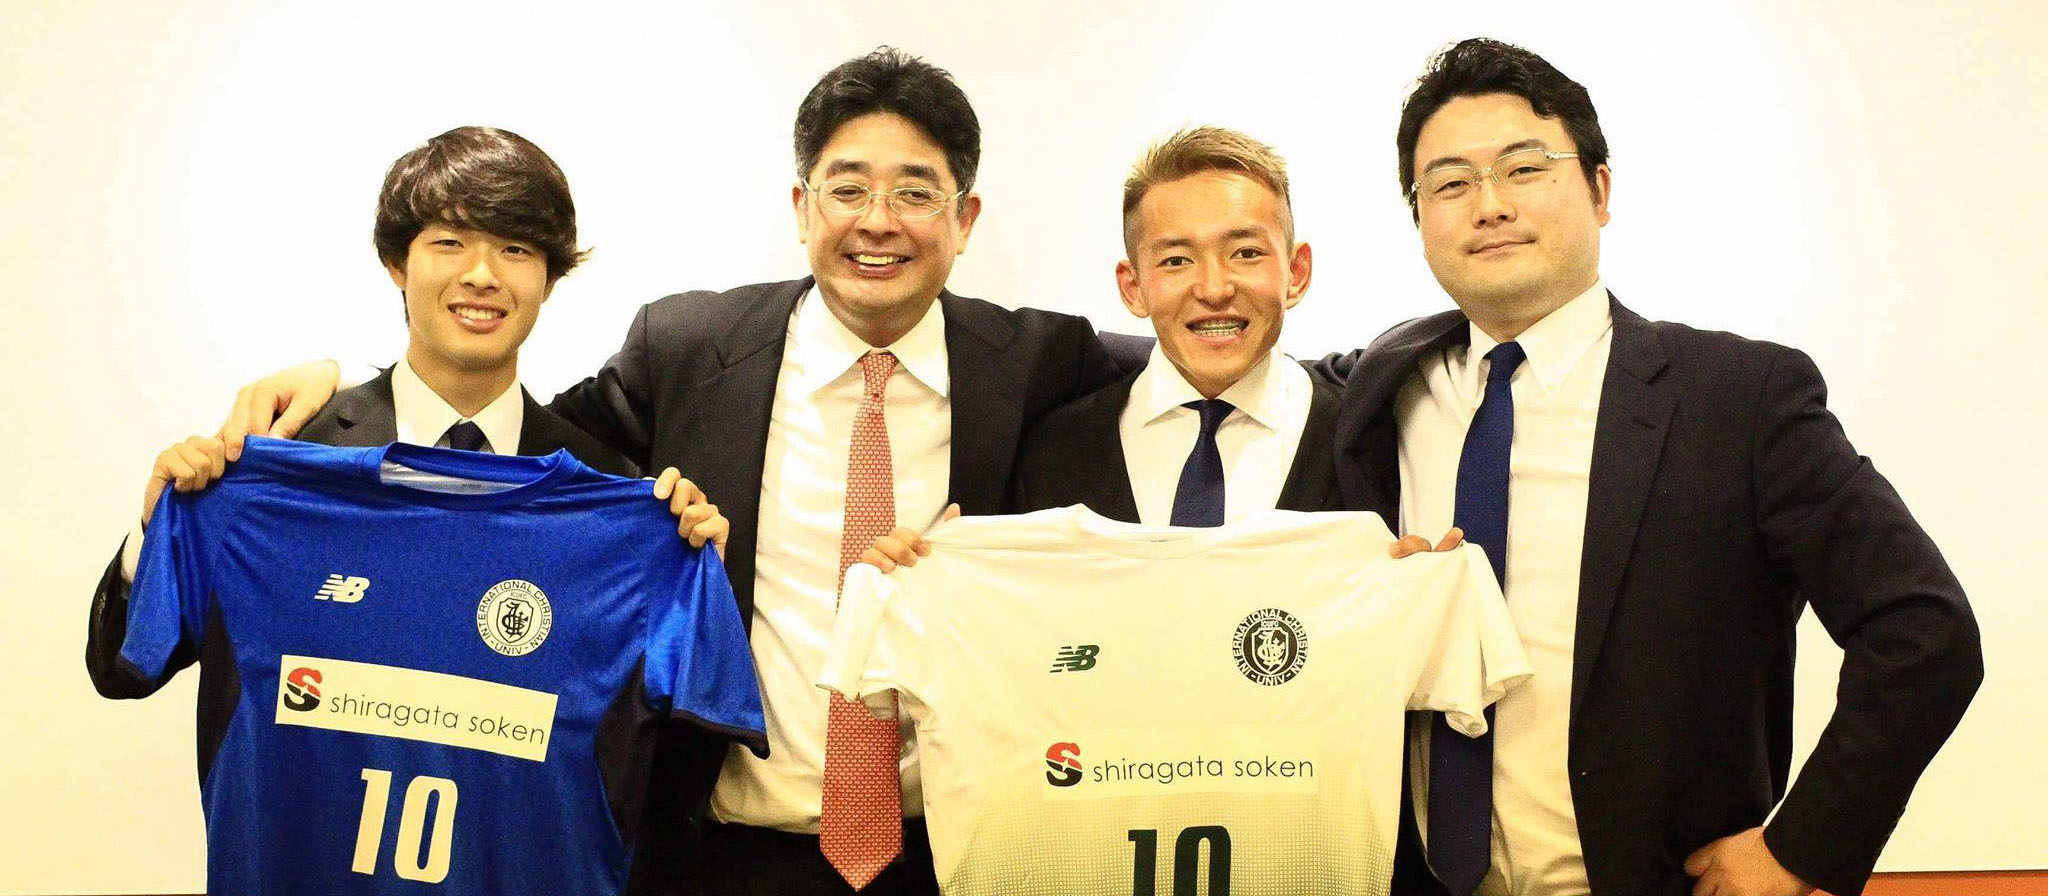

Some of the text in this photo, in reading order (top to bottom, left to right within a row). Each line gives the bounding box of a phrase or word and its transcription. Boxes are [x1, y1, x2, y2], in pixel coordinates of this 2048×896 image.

[478, 581, 551, 649] INTERNATIONAL CHRISTIAN
[1232, 608, 1308, 676] INTERNATIONAL CHRISTIAN
[329, 693, 459, 727] shiragata
[468, 713, 545, 745] soken
[1093, 754, 1223, 784] shiragata
[1234, 755, 1314, 778] soken
[351, 767, 458, 884] 10
[1127, 825, 1232, 896] 10
